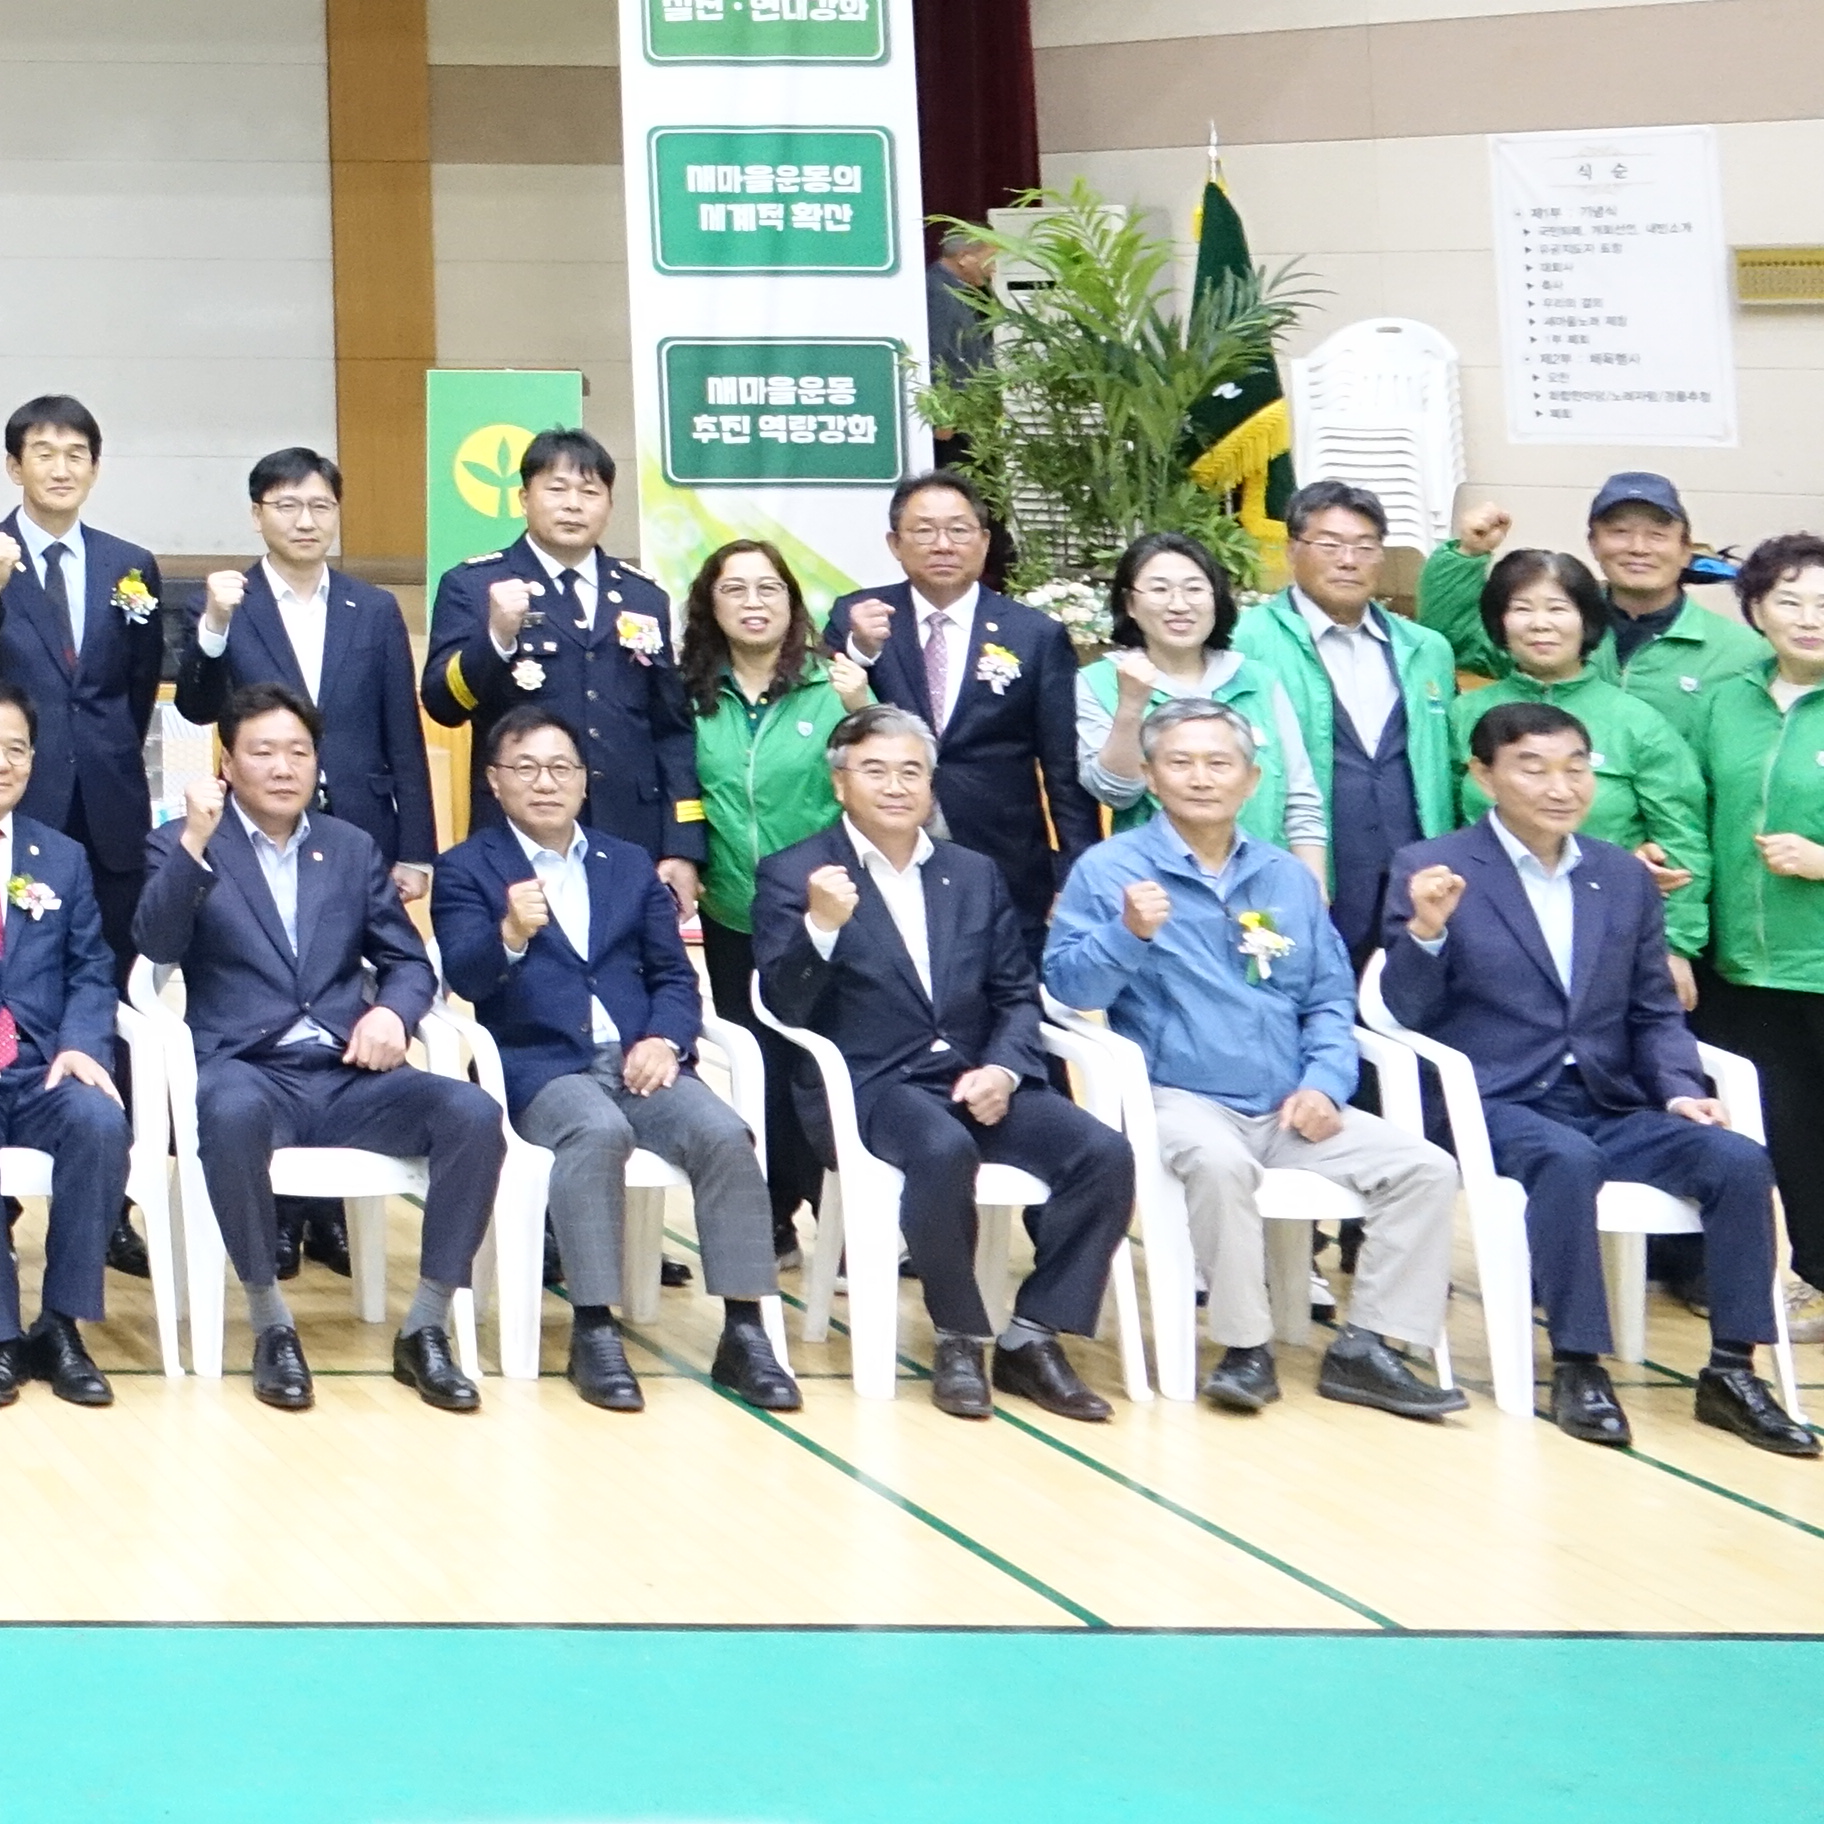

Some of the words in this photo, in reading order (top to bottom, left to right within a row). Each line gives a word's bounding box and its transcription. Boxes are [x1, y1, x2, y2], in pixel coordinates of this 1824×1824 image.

[685, 164, 863, 194] 새마을운동의
[699, 202, 785, 232] 세계적
[790, 201, 853, 232] 확산
[706, 375, 857, 406] 새마을운동
[691, 413, 751, 444] 추진
[758, 413, 878, 444] 역량강화
